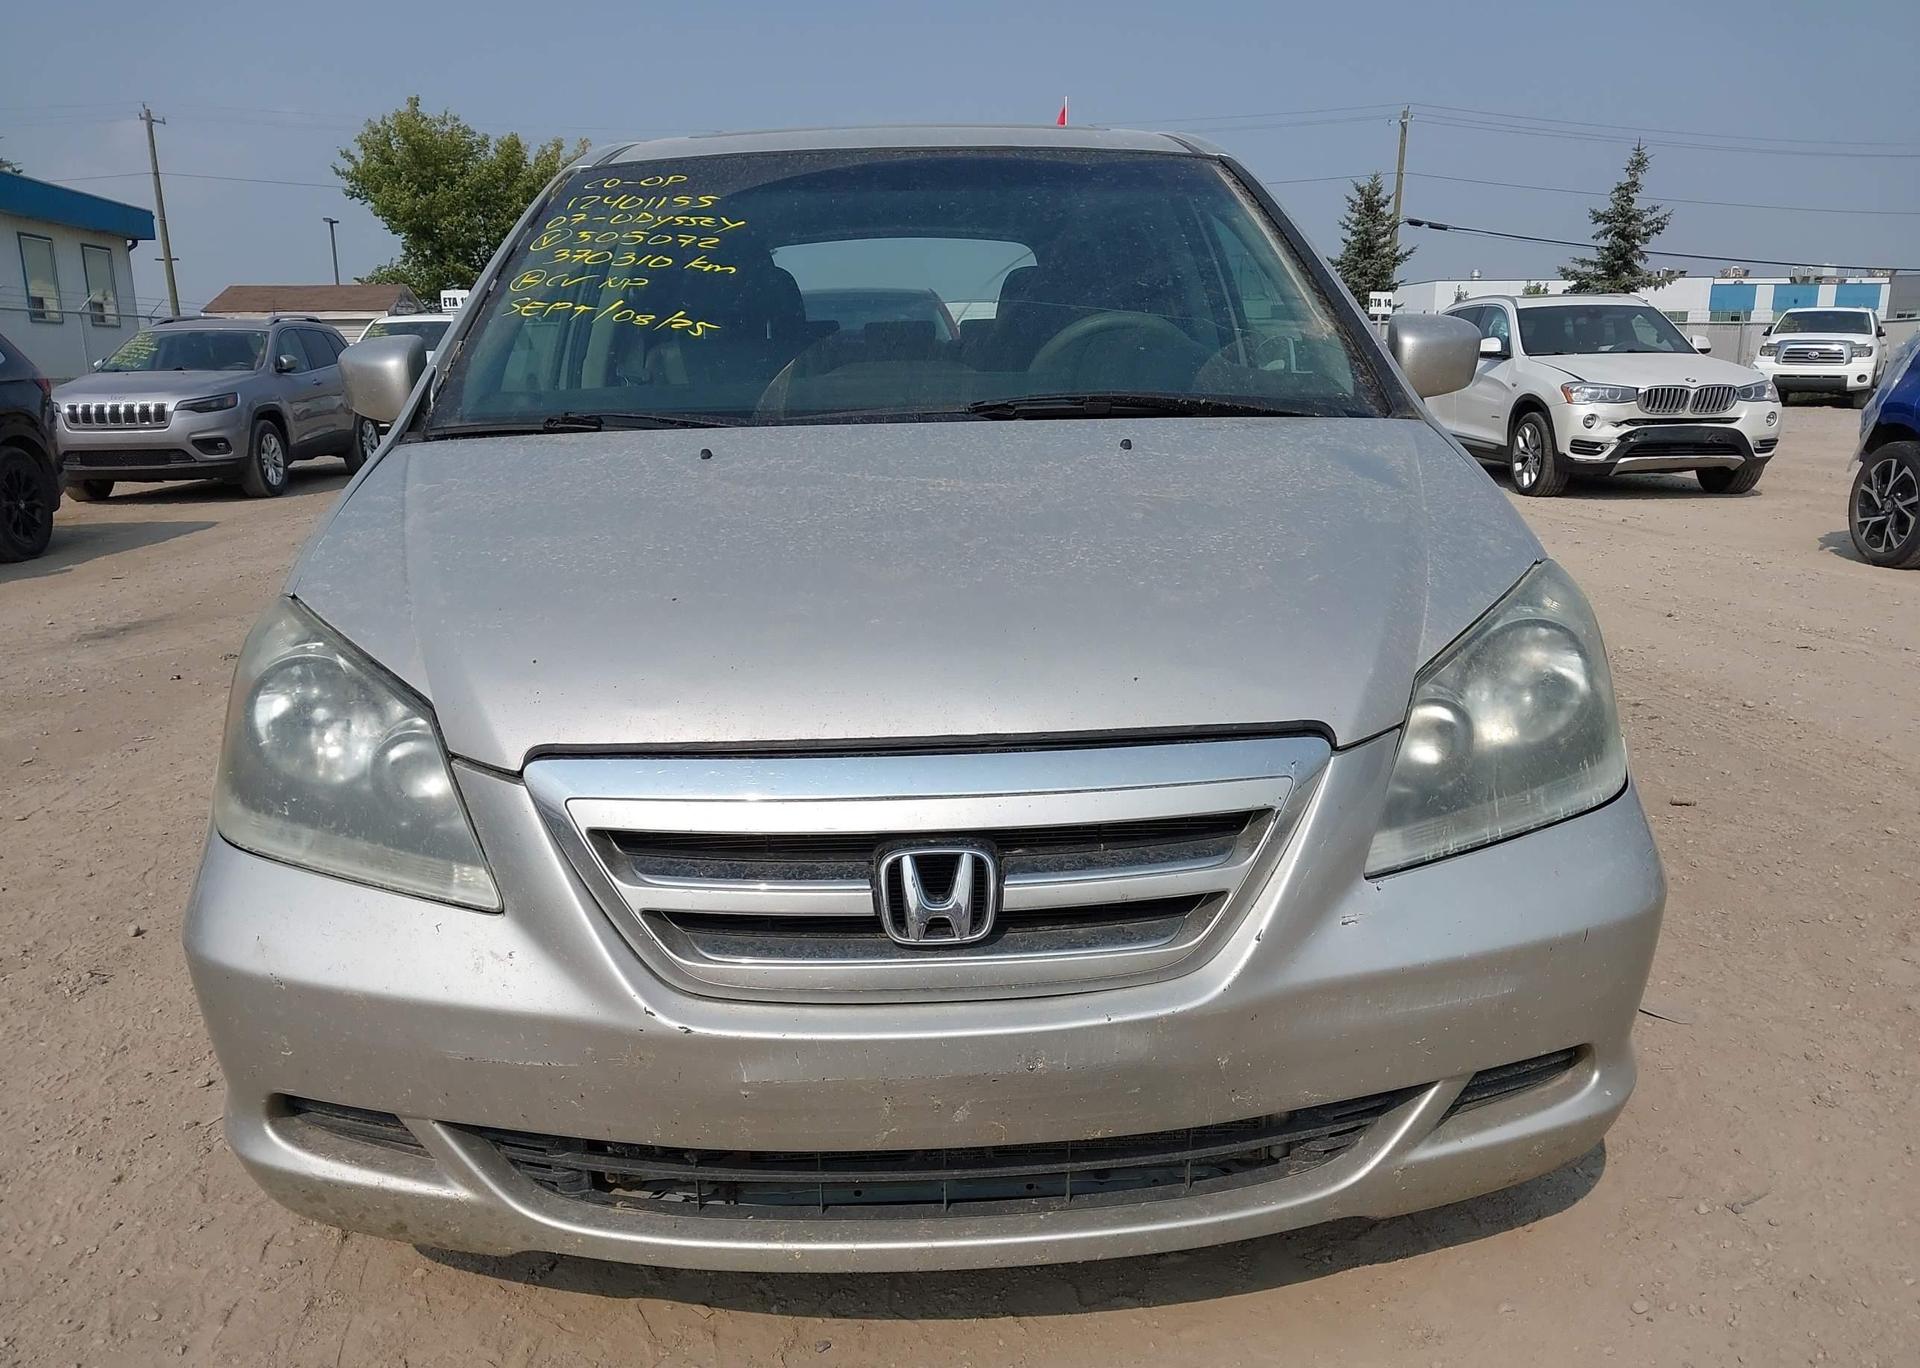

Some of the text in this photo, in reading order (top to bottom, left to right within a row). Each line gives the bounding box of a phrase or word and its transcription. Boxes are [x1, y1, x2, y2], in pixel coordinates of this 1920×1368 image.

[584, 175, 688, 189] CO-OP
[443, 297, 458, 307] ETA
[1370, 298, 1392, 308] ETA 14
